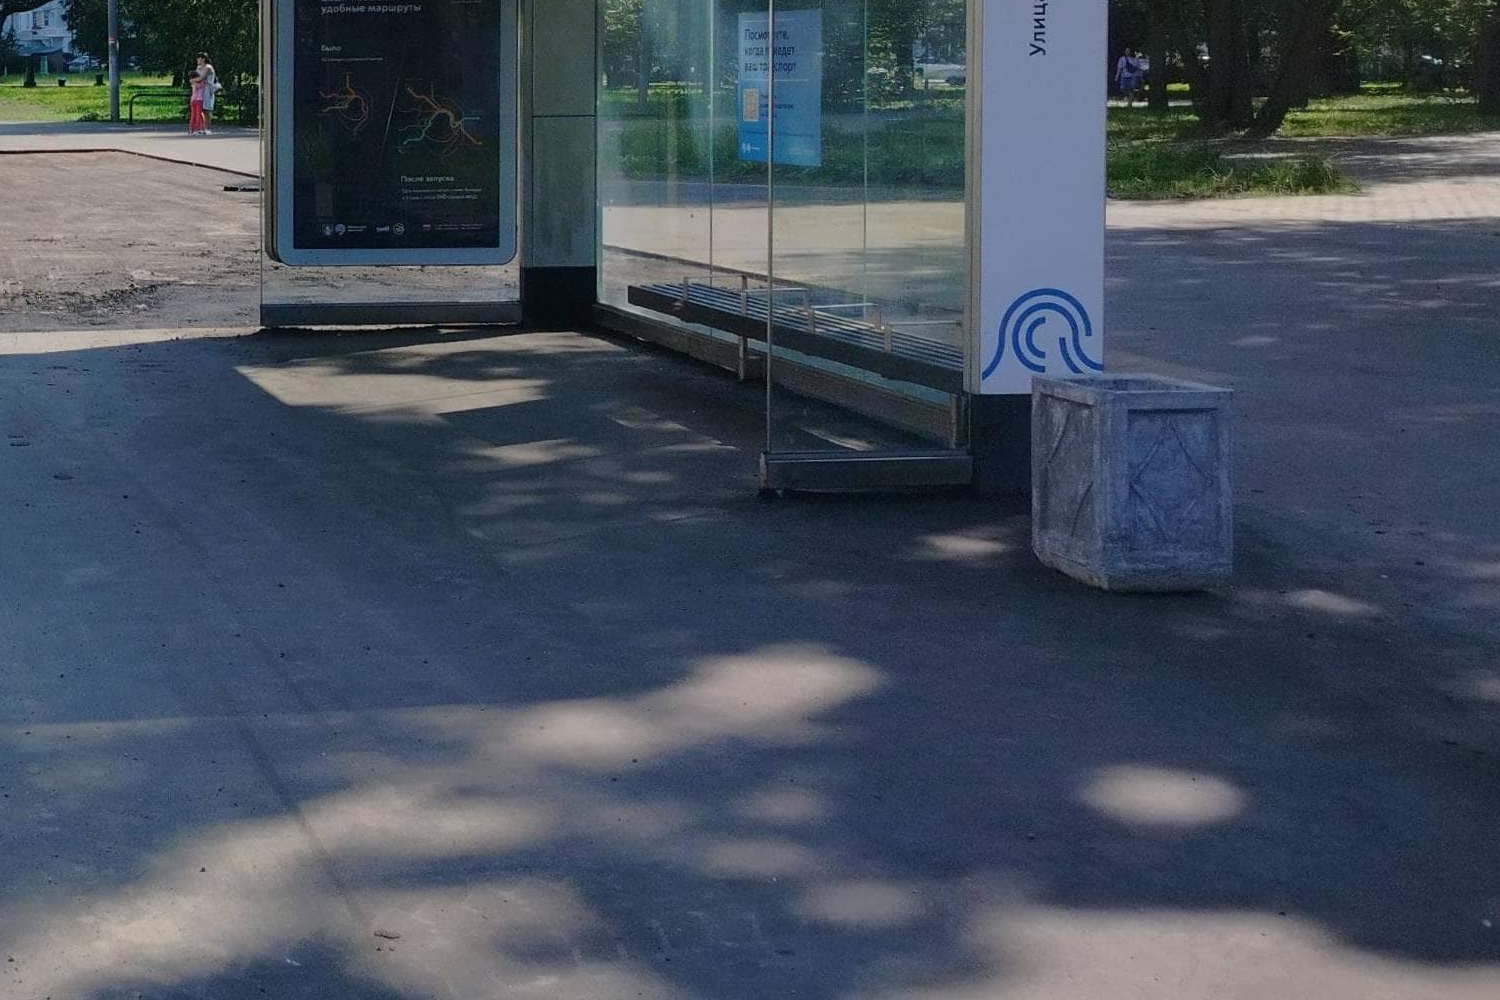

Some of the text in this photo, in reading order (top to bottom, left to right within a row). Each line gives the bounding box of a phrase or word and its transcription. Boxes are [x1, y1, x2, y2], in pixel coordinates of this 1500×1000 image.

[321, 4, 422, 15] удобные маршруты
[765, 46, 795, 58] пиедет
[760, 62, 797, 73] трспорт
